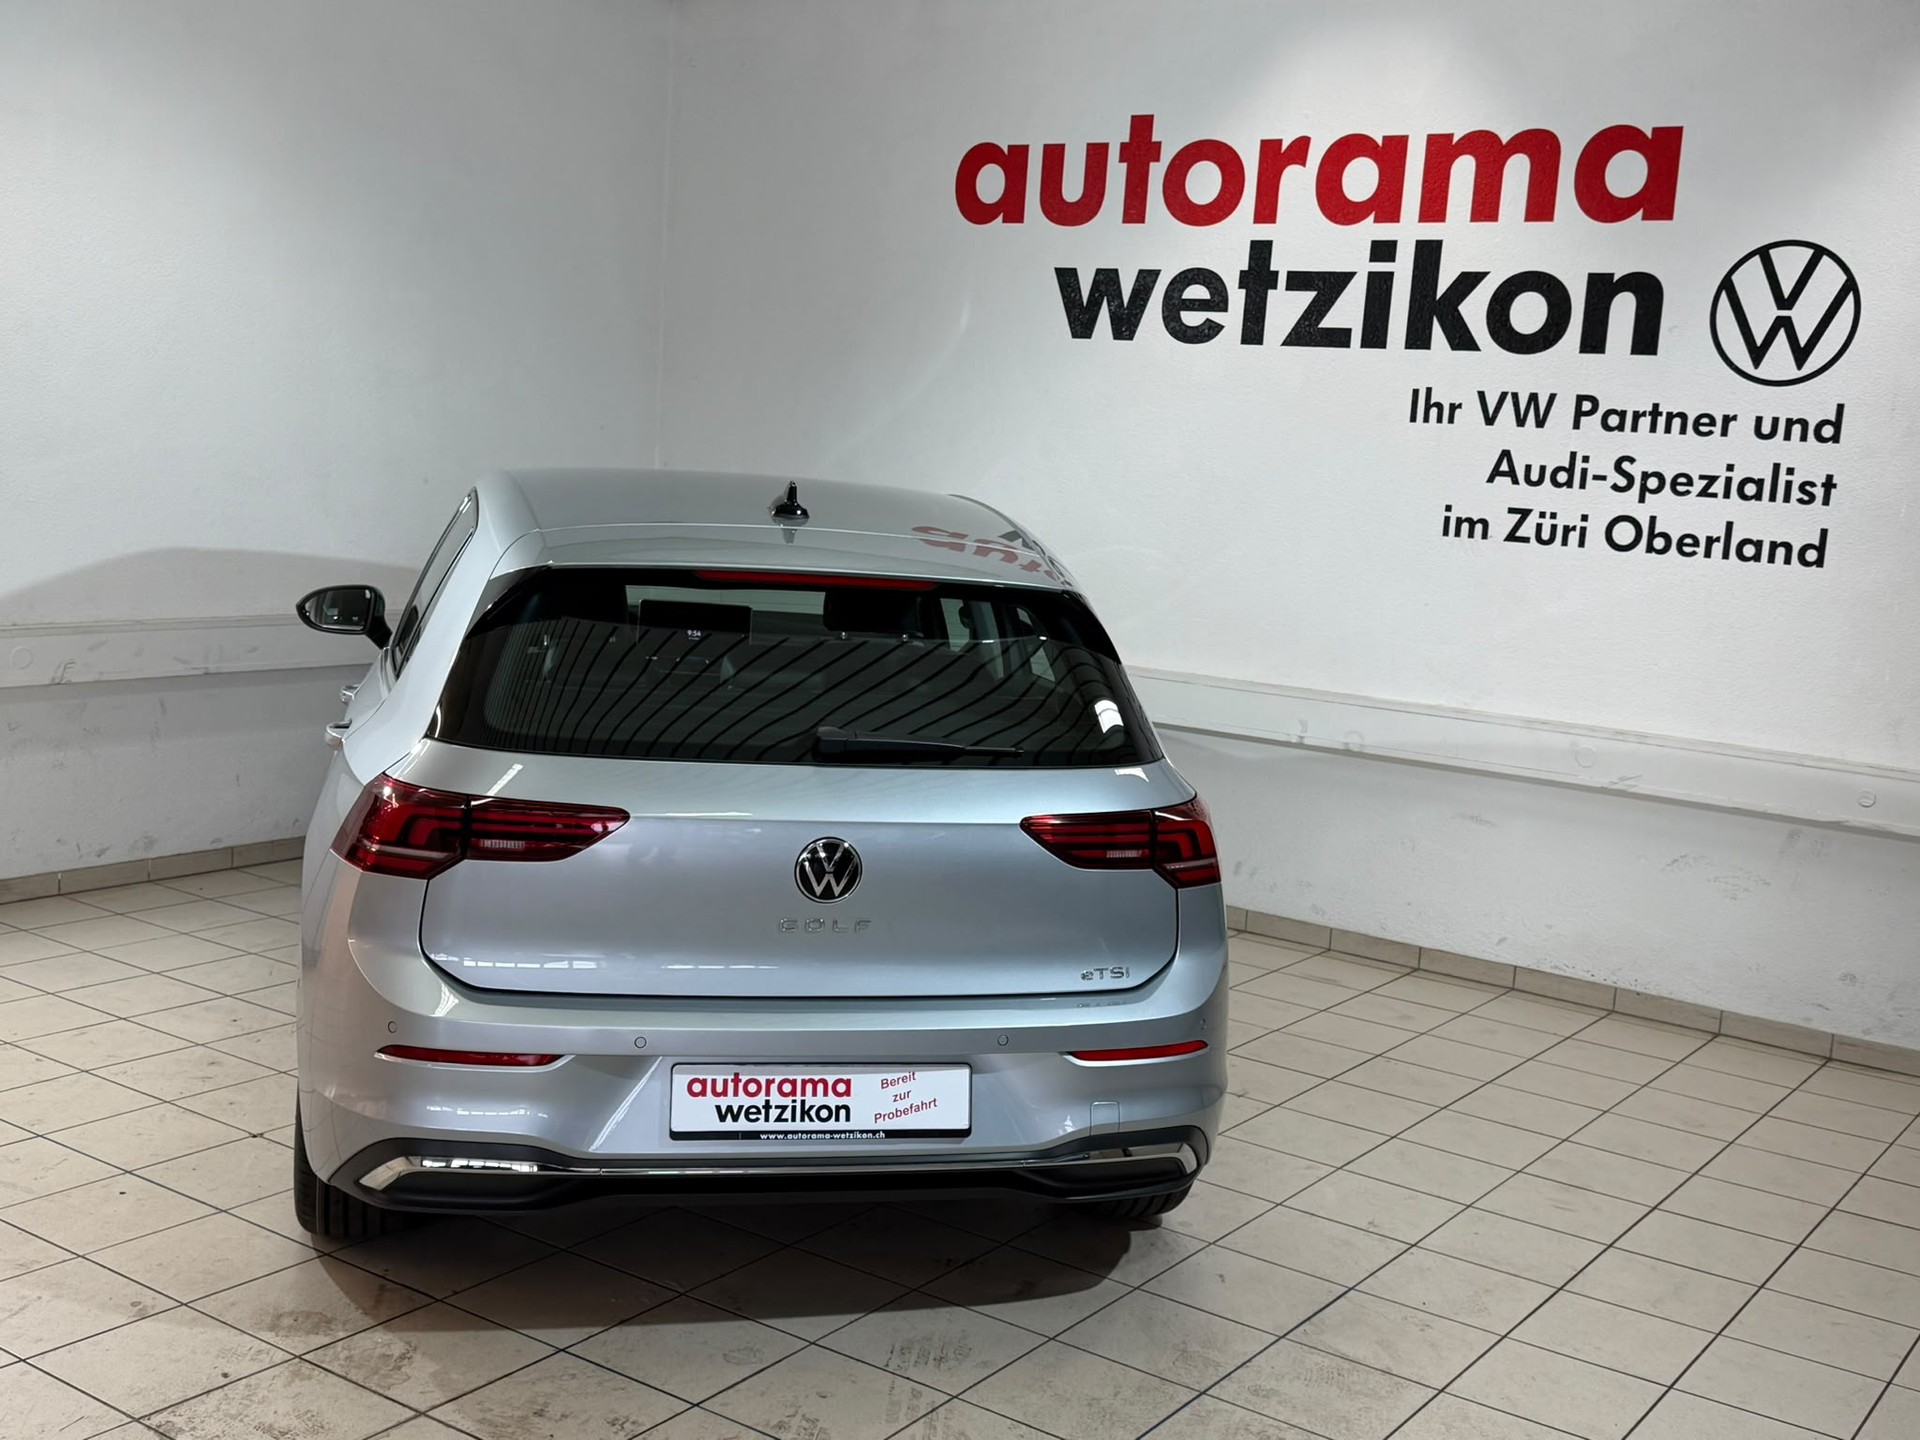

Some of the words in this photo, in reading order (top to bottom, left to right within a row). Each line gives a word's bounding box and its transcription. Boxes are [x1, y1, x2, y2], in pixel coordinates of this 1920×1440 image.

[956, 115, 1683, 227] autorama
[1054, 239, 1664, 355] wetzikon
[1409, 387, 1463, 425] Ihr
[1477, 390, 1557, 429] VW
[1572, 394, 1738, 438] Partner
[1753, 403, 1845, 444] und
[1486, 449, 1838, 507] Audi-Spezialist
[1442, 504, 1490, 540] im
[1504, 506, 1589, 549] Züri
[1604, 514, 1829, 569] Oberland
[779, 918, 872, 933] GOLF
[687, 1072, 852, 1099] autorama
[880, 1071, 917, 1090] Bereit
[892, 1089, 912, 1103] zur
[715, 1098, 851, 1123] wetzikon
[874, 1098, 938, 1124] Probefahrt
[759, 1131, 886, 1140] www.autorama-wetzikon.ch
